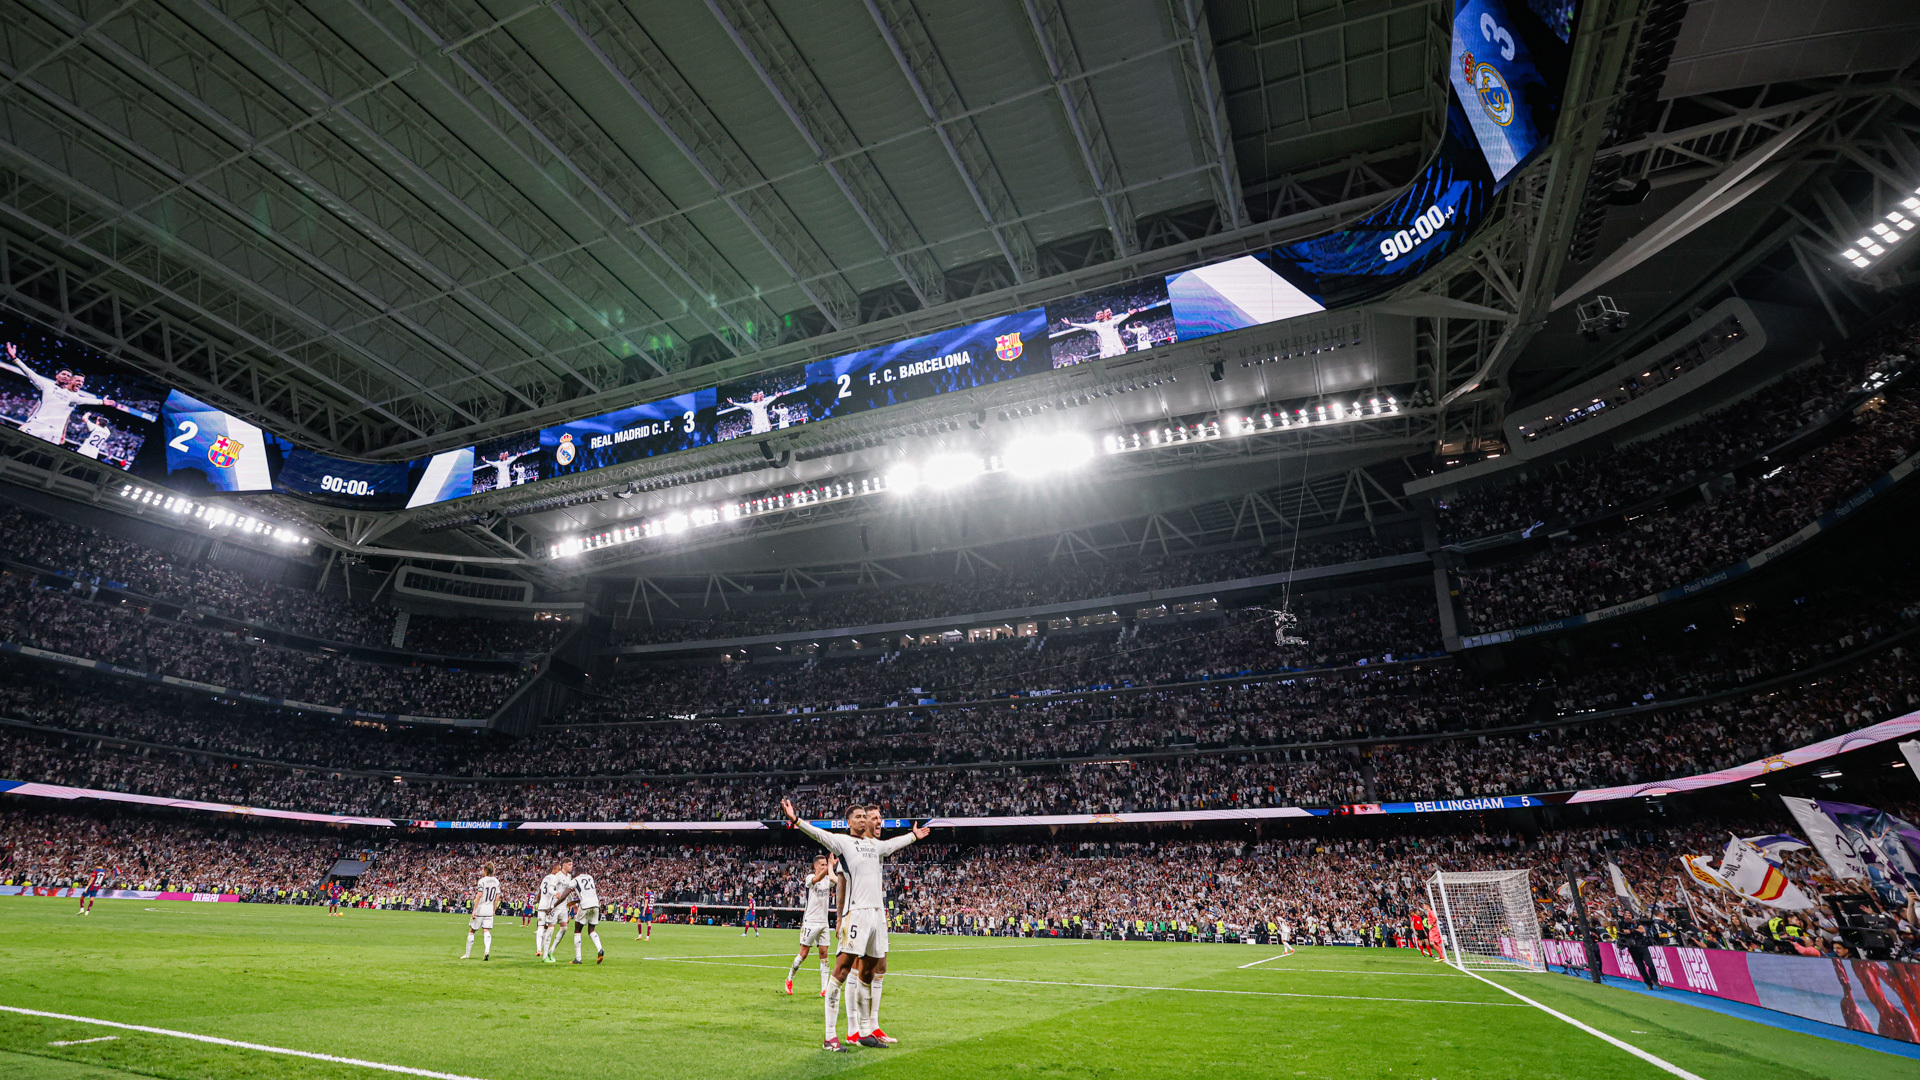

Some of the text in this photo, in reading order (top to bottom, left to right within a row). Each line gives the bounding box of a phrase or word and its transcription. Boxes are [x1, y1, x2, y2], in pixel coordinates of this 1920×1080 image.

[1480, 12, 1515, 61] 3
[837, 350, 971, 399] 2 F. C. BARCELONA
[168, 420, 199, 453] 2
[590, 410, 696, 450] REAL MADRID C. F. 3
[1683, 571, 1728, 594] Real Madrid
[1598, 601, 1647, 620] Real Madrid
[1515, 621, 1564, 637] Real Madrid
[1414, 795, 1531, 813] BELLINGHAM 5
[450, 821, 503, 829] BELLINGHAM 5
[895, 820, 901, 828] 5
[485, 886, 497, 902] 10
[542, 881, 548, 895] 3
[191, 892, 220, 902] DUBAI
[803, 927, 812, 937] 17
[850, 924, 858, 939] 5
